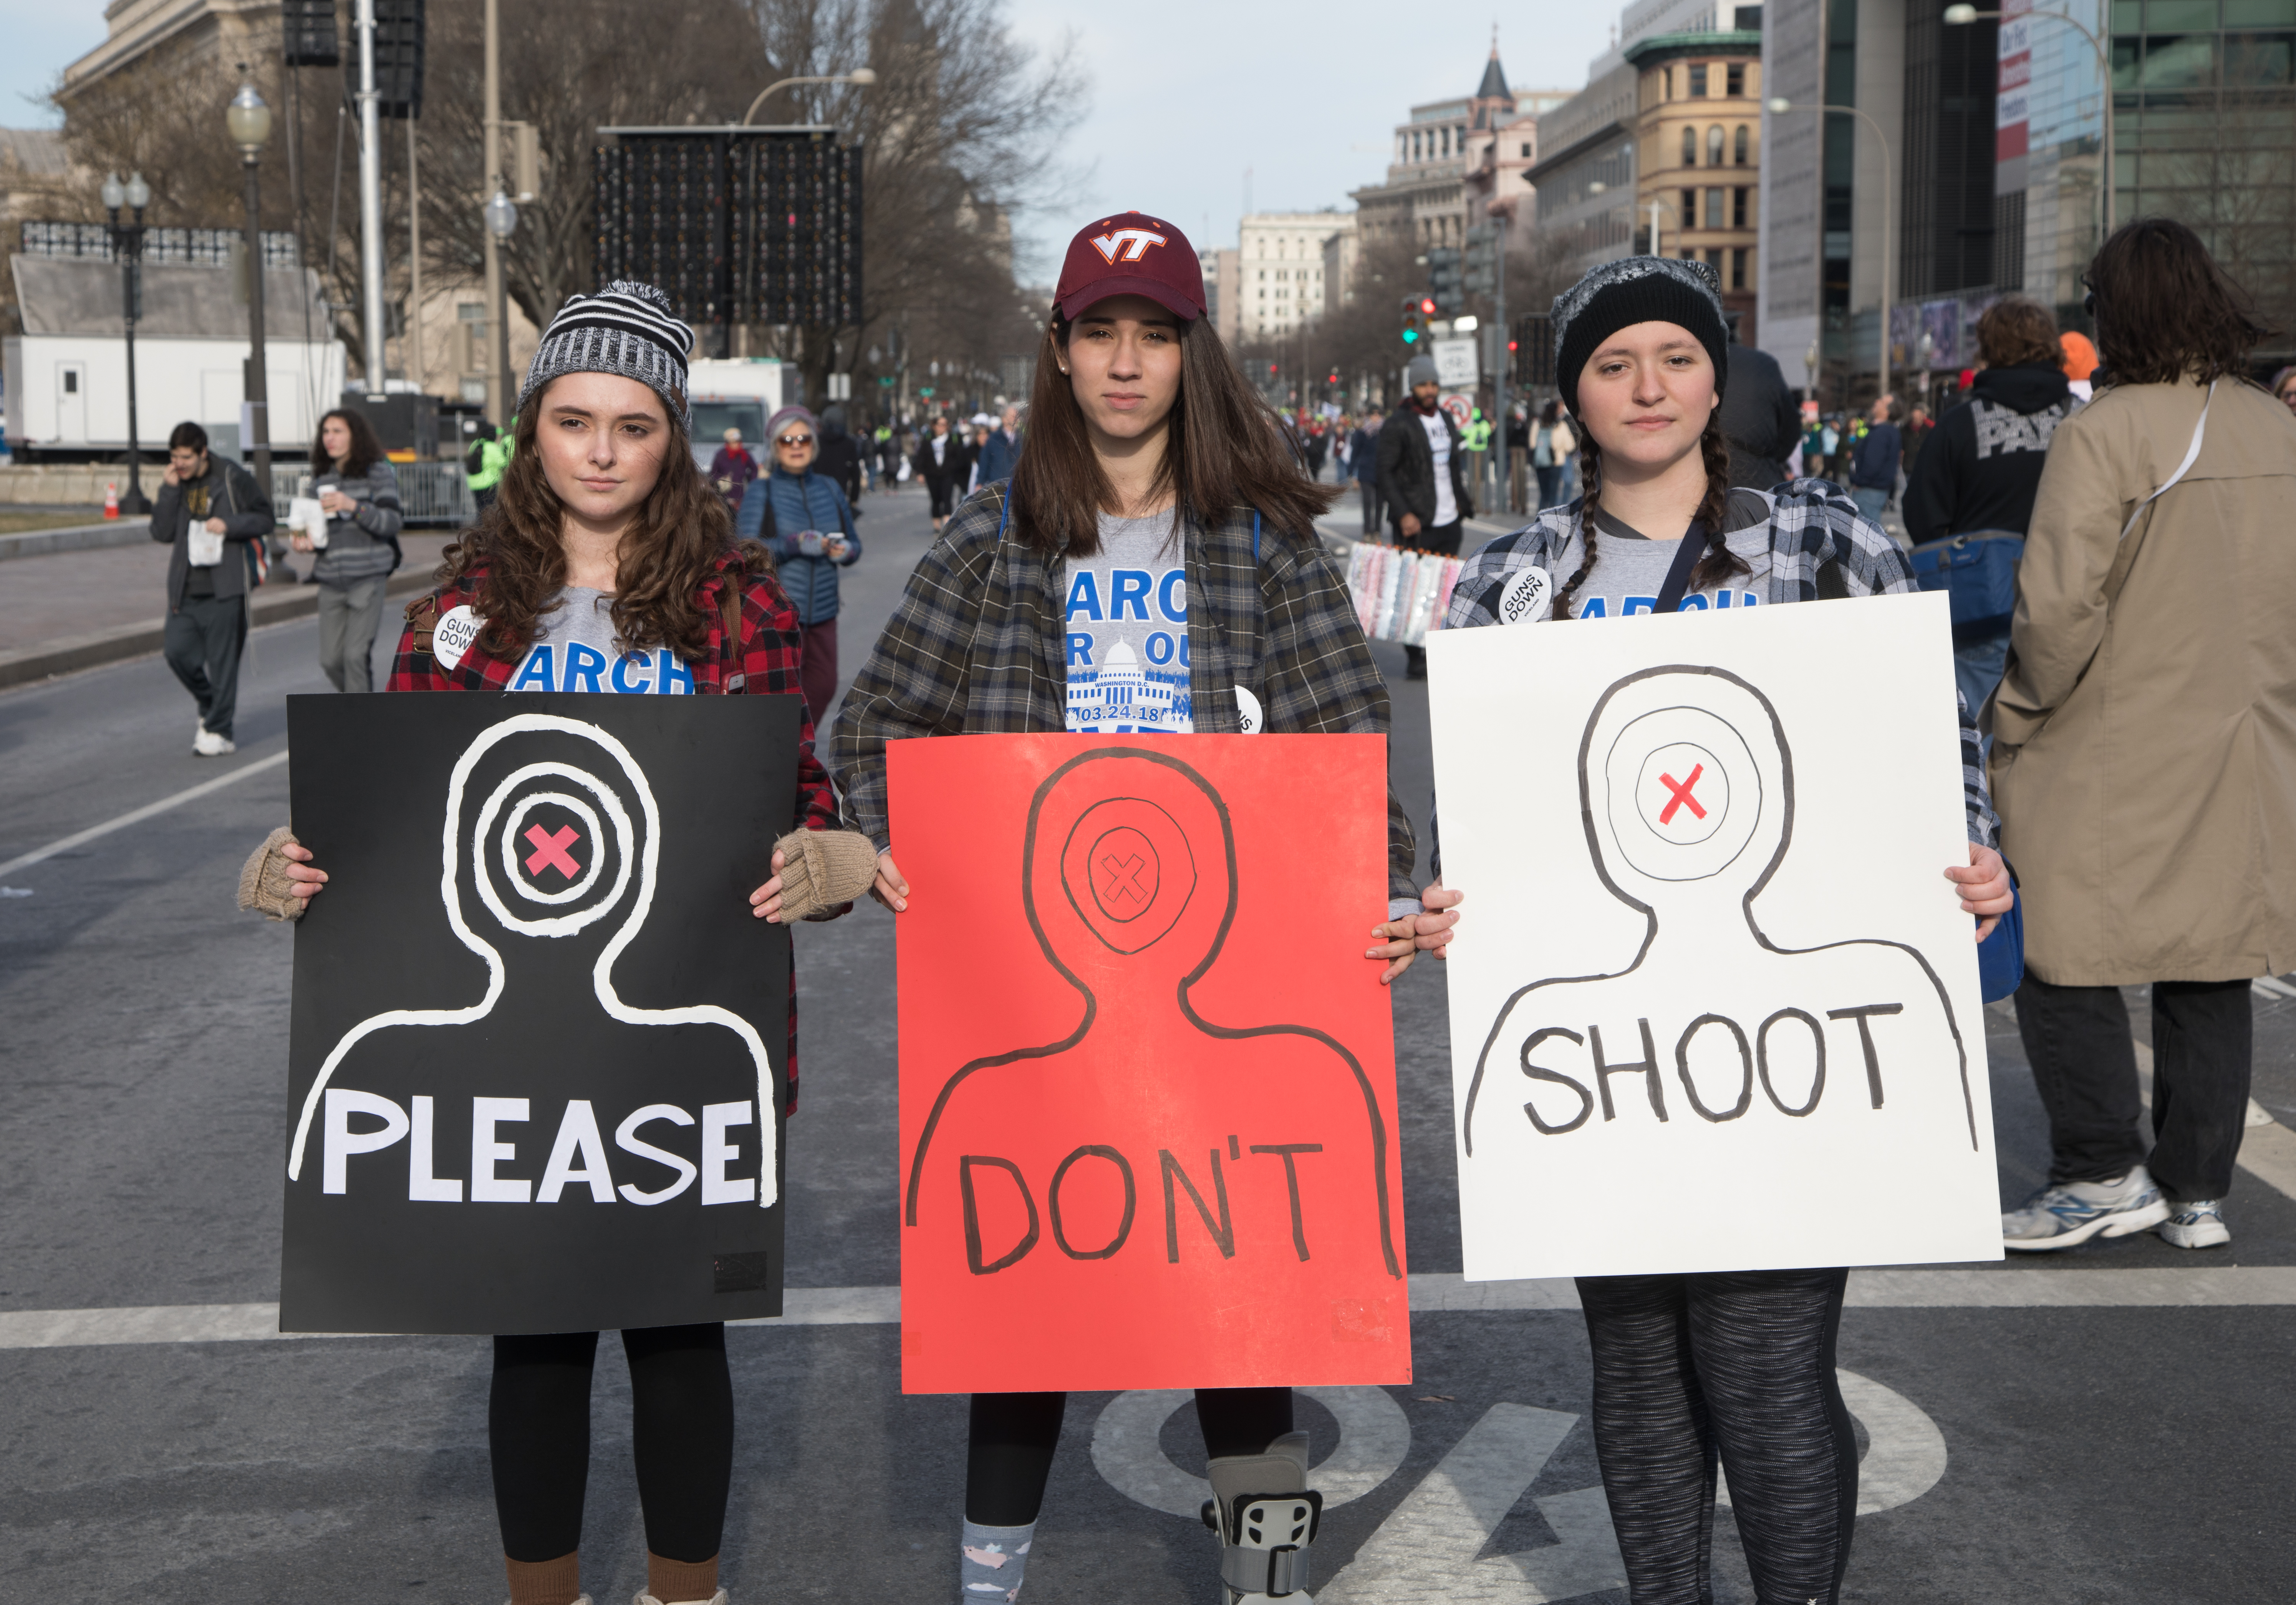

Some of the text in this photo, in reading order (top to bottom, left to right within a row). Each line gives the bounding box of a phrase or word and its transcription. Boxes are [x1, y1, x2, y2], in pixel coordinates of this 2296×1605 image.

[1089, 227, 1168, 265] VT
[1505, 574, 1535, 611] GUNS
[1509, 579, 1543, 622] DOWN
[1524, 599, 1539, 617] VICELAND
[1080, 705, 1159, 722] 03.24.18
[1520, 1003, 1903, 1135] SHOOT
[323, 1088, 755, 1206] PLEASE
[960, 1135, 1323, 1275] DON'T
